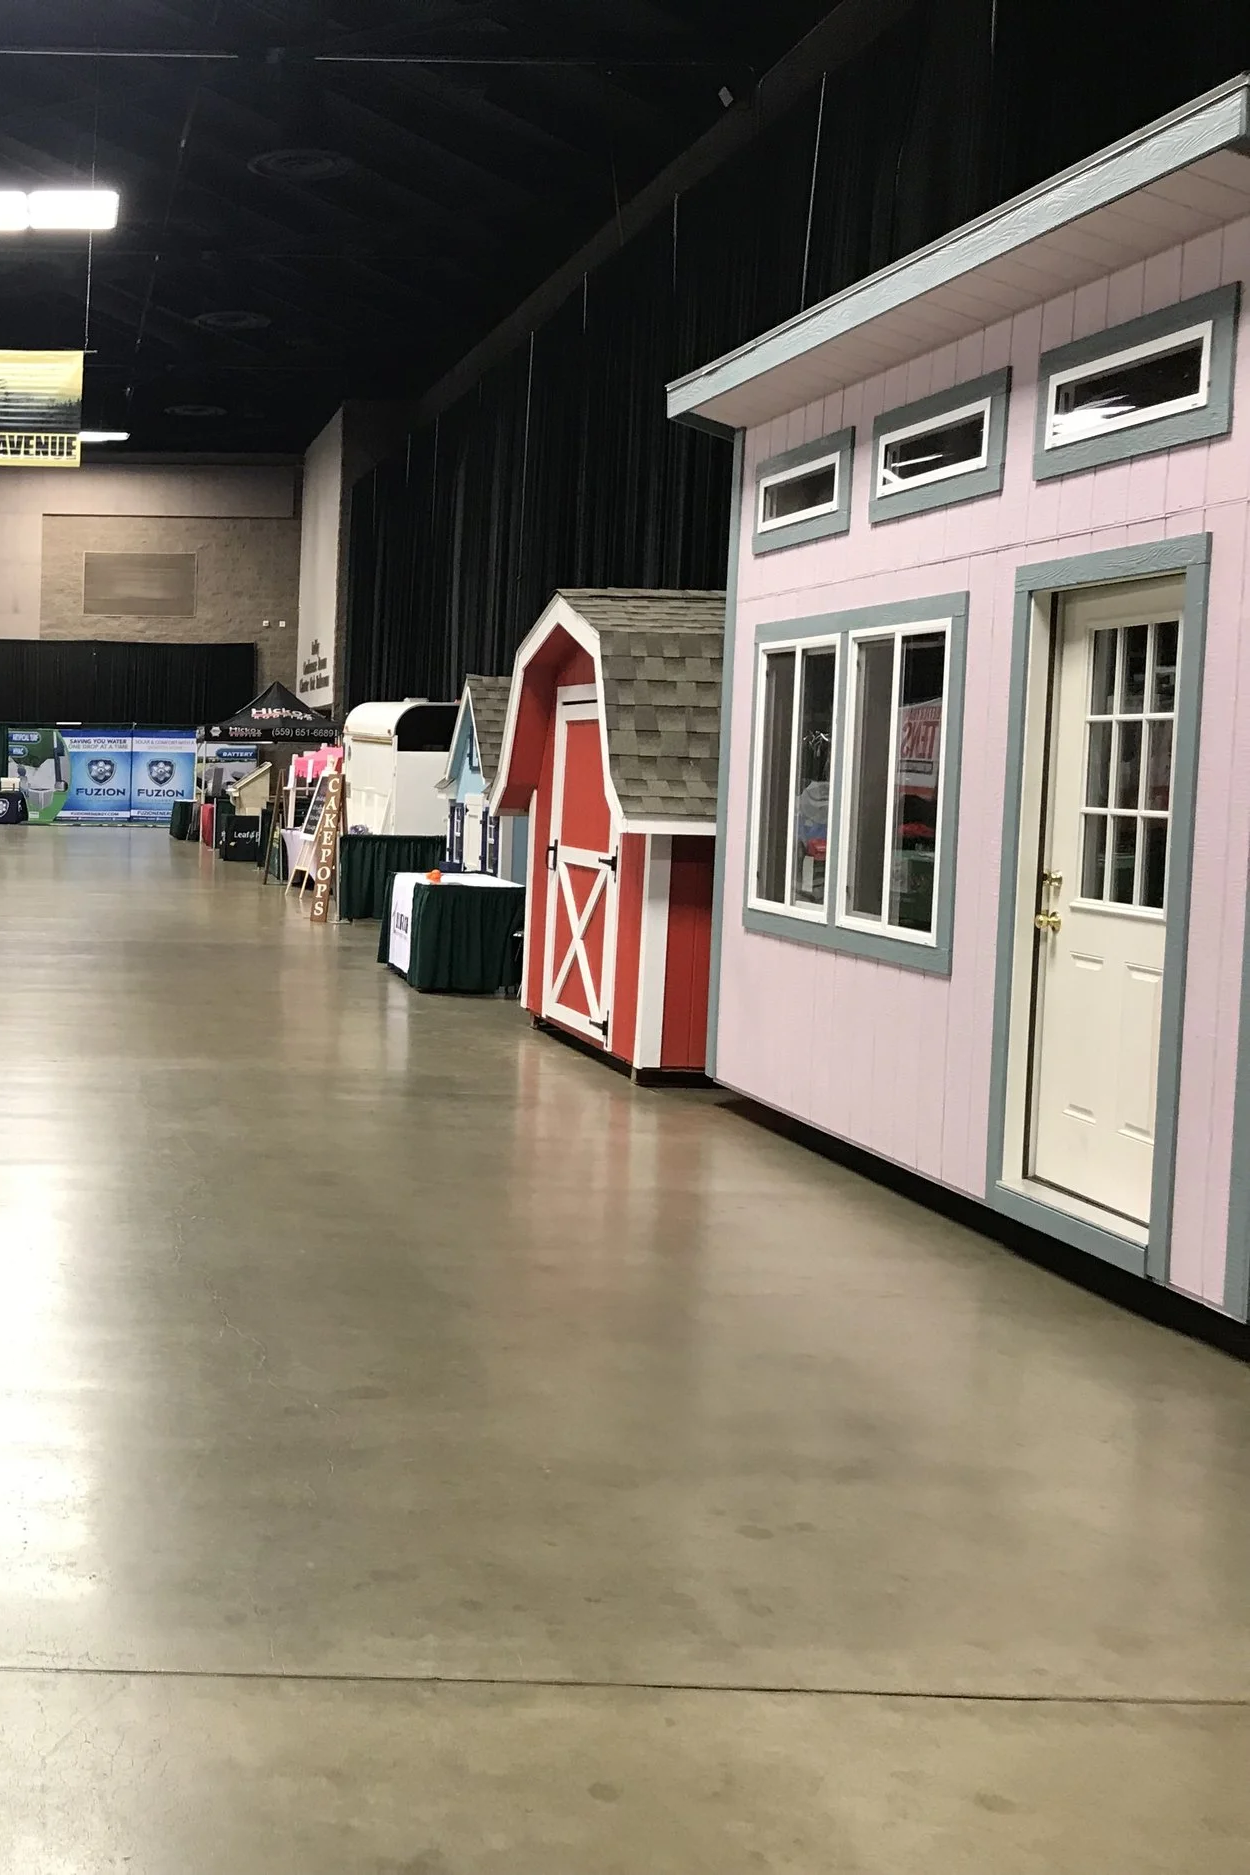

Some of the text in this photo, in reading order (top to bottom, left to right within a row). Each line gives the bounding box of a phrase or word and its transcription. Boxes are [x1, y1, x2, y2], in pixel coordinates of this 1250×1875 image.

[271, 728, 293, 737] (559)
[76, 788, 126, 797] FUZION
[137, 788, 185, 798] FUZION
